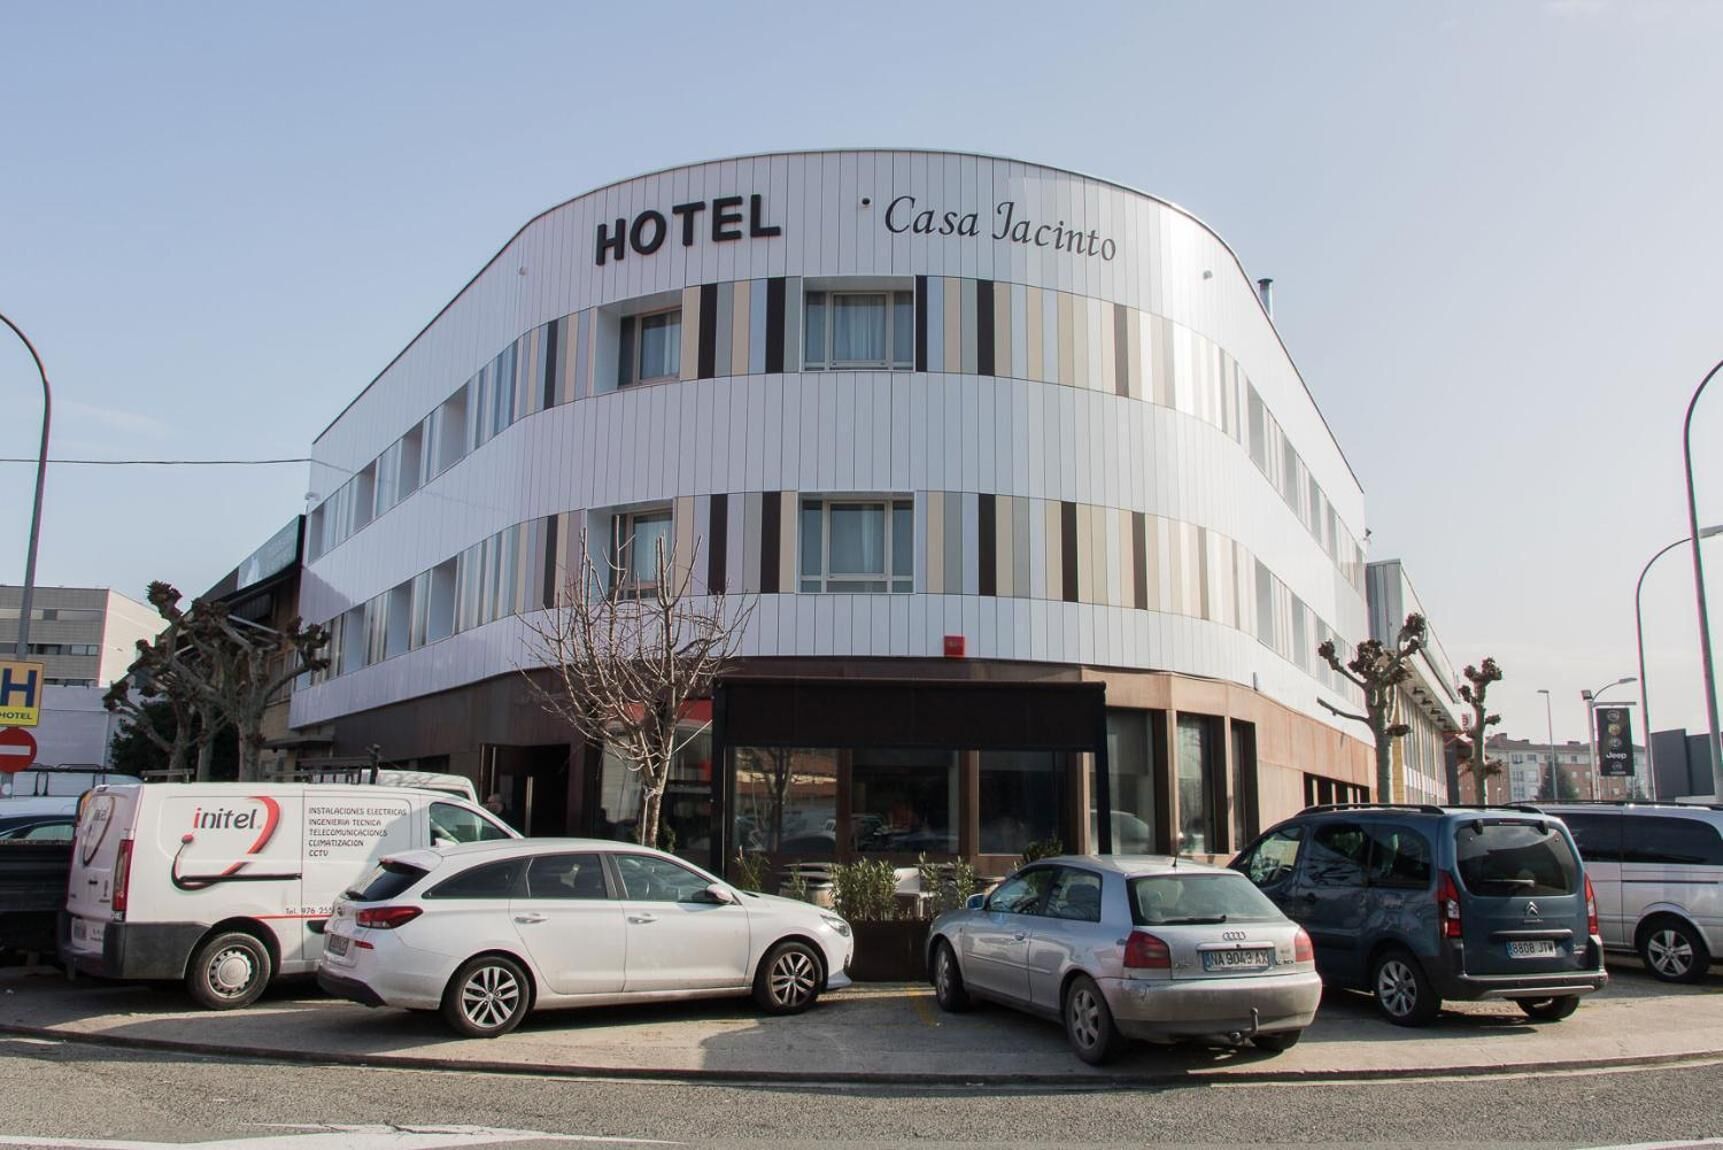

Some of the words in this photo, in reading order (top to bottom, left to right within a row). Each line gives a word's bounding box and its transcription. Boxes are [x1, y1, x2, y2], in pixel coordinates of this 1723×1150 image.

[596, 194, 781, 266] HOTEL
[885, 196, 980, 237] Casa
[992, 202, 1117, 261] Jacinto
[0, 668, 37, 707] H
[1606, 751, 1627, 760] Jeep
[308, 807, 364, 815] INSTALACIONES
[366, 808, 407, 816] ELECTRICAS
[193, 807, 258, 829] initel
[308, 818, 350, 826] INGENIERIA
[352, 819, 382, 827] TECNICA
[308, 828, 389, 837] TELECOMUNICACIONES
[308, 839, 364, 847] CLIMATIZACION
[308, 849, 329, 857] CCTV
[1211, 951, 1225, 965] NA
